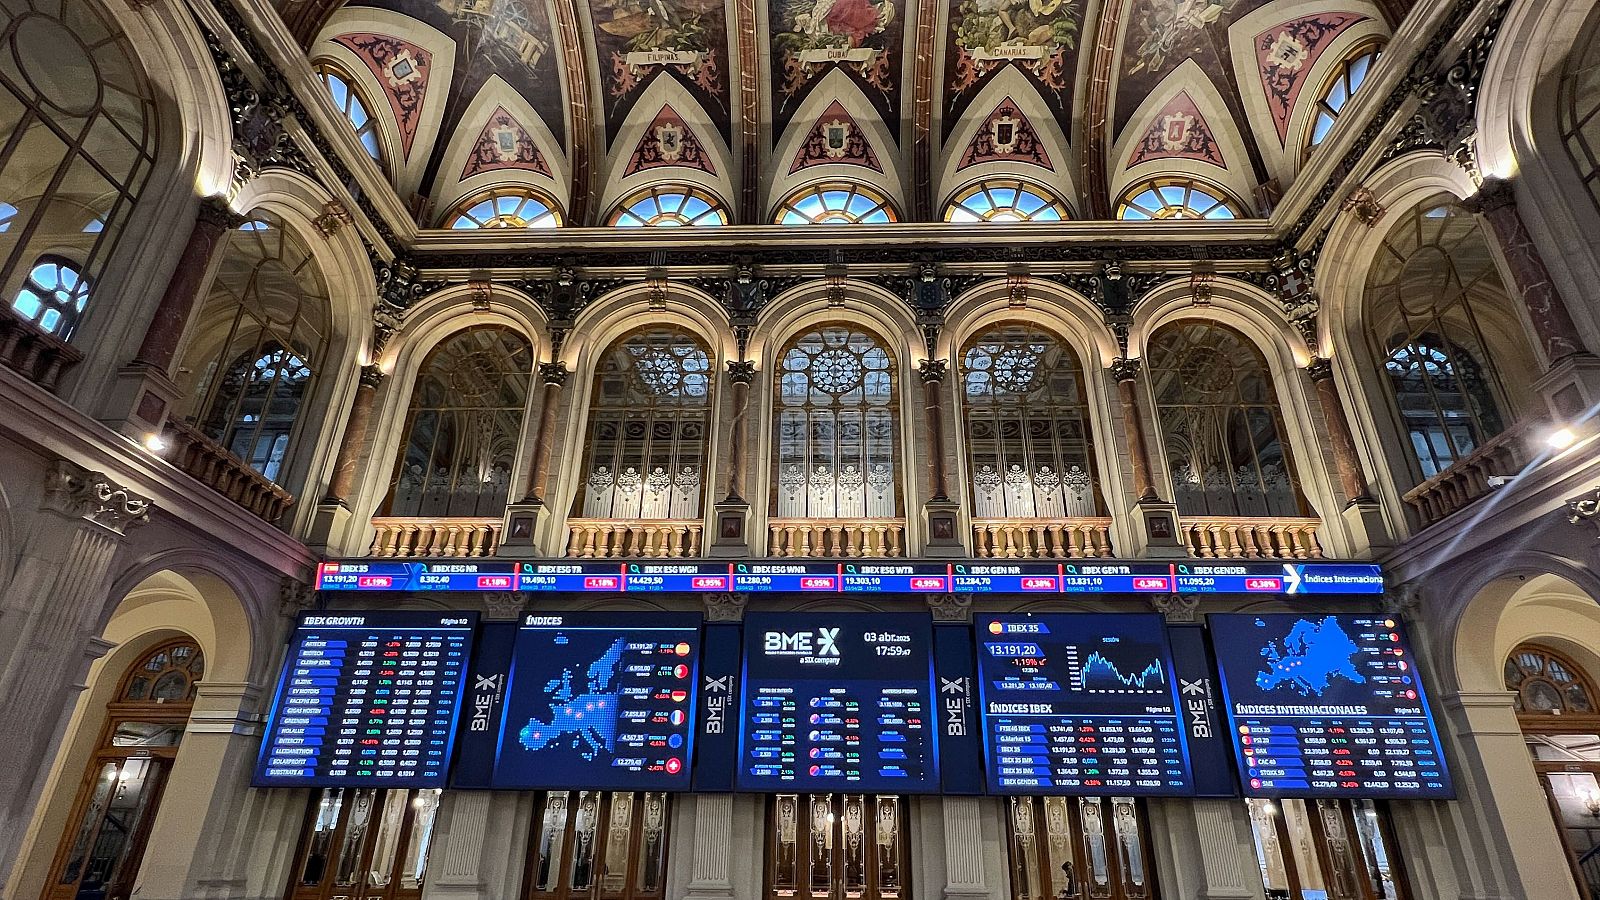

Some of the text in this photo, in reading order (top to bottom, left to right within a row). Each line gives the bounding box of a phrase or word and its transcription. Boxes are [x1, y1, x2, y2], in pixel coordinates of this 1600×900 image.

[1304, 574, 1333, 582] Índices
[326, 617, 365, 625] GROWTH
[526, 615, 562, 625] ÍNDICES
[765, 632, 813, 650] BME
[864, 632, 876, 642] 03
[990, 646, 1036, 655] 13.191,20
[471, 694, 490, 731] BME
[990, 702, 1028, 713] ÍNDICES
[1030, 704, 1052, 713] IBEX
[1236, 703, 1276, 714] ÍNDICES
[1277, 705, 1367, 715] INTERNACIONALES
[706, 697, 722, 733] BME
[946, 698, 962, 735] BME
[1188, 700, 1209, 737] BME
